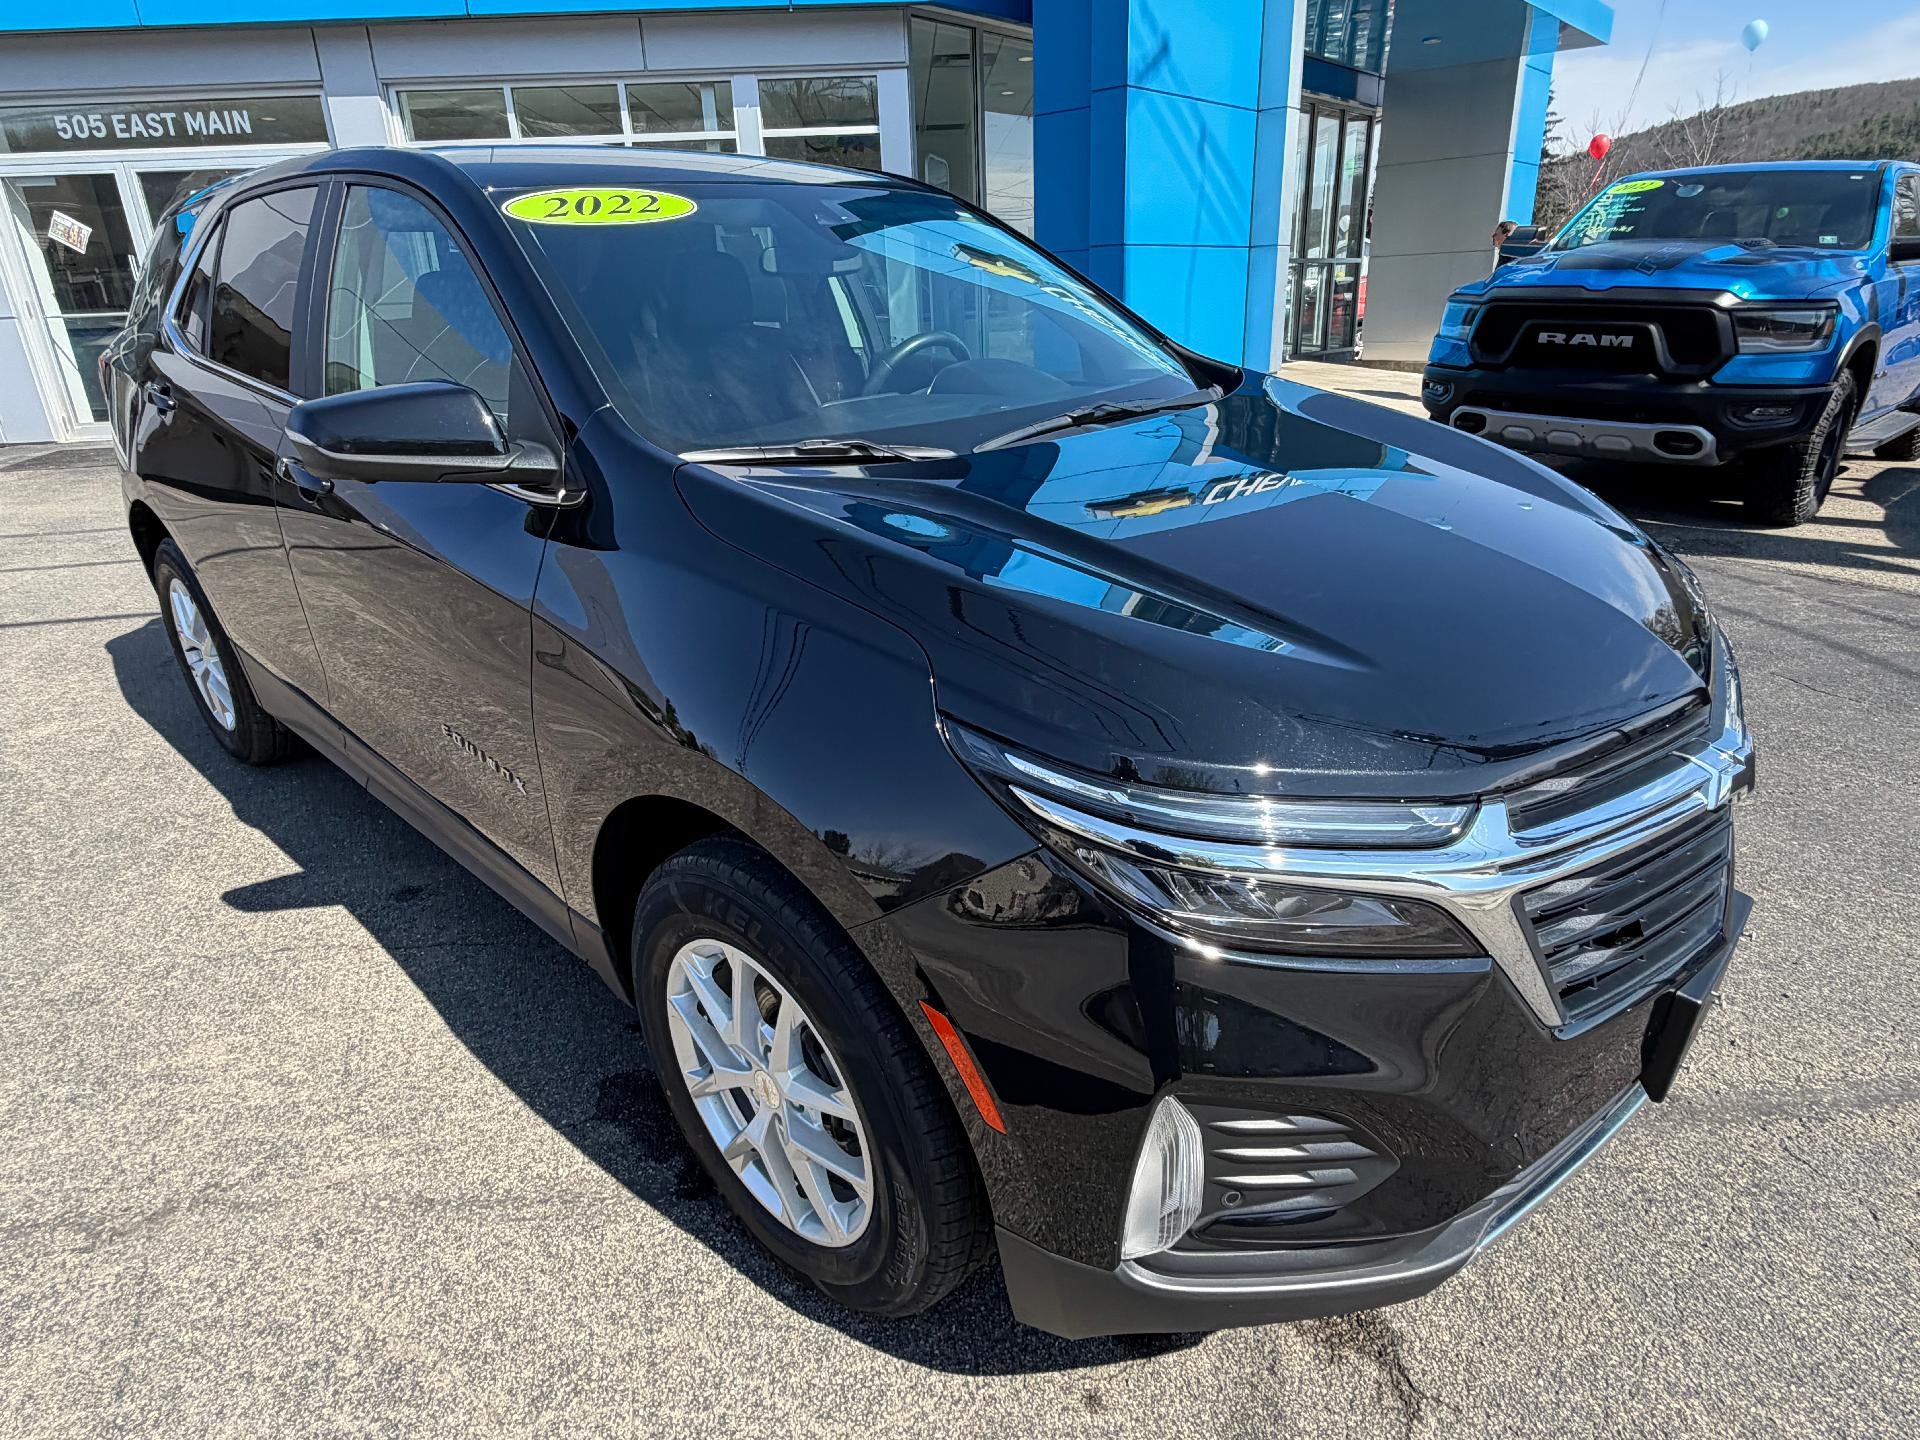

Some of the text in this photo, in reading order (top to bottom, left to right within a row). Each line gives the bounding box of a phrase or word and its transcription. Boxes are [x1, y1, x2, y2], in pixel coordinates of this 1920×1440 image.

[54, 110, 252, 139] 505 EAST MAIN
[544, 195, 660, 218] 2022
[1537, 332, 1634, 347] RAM
